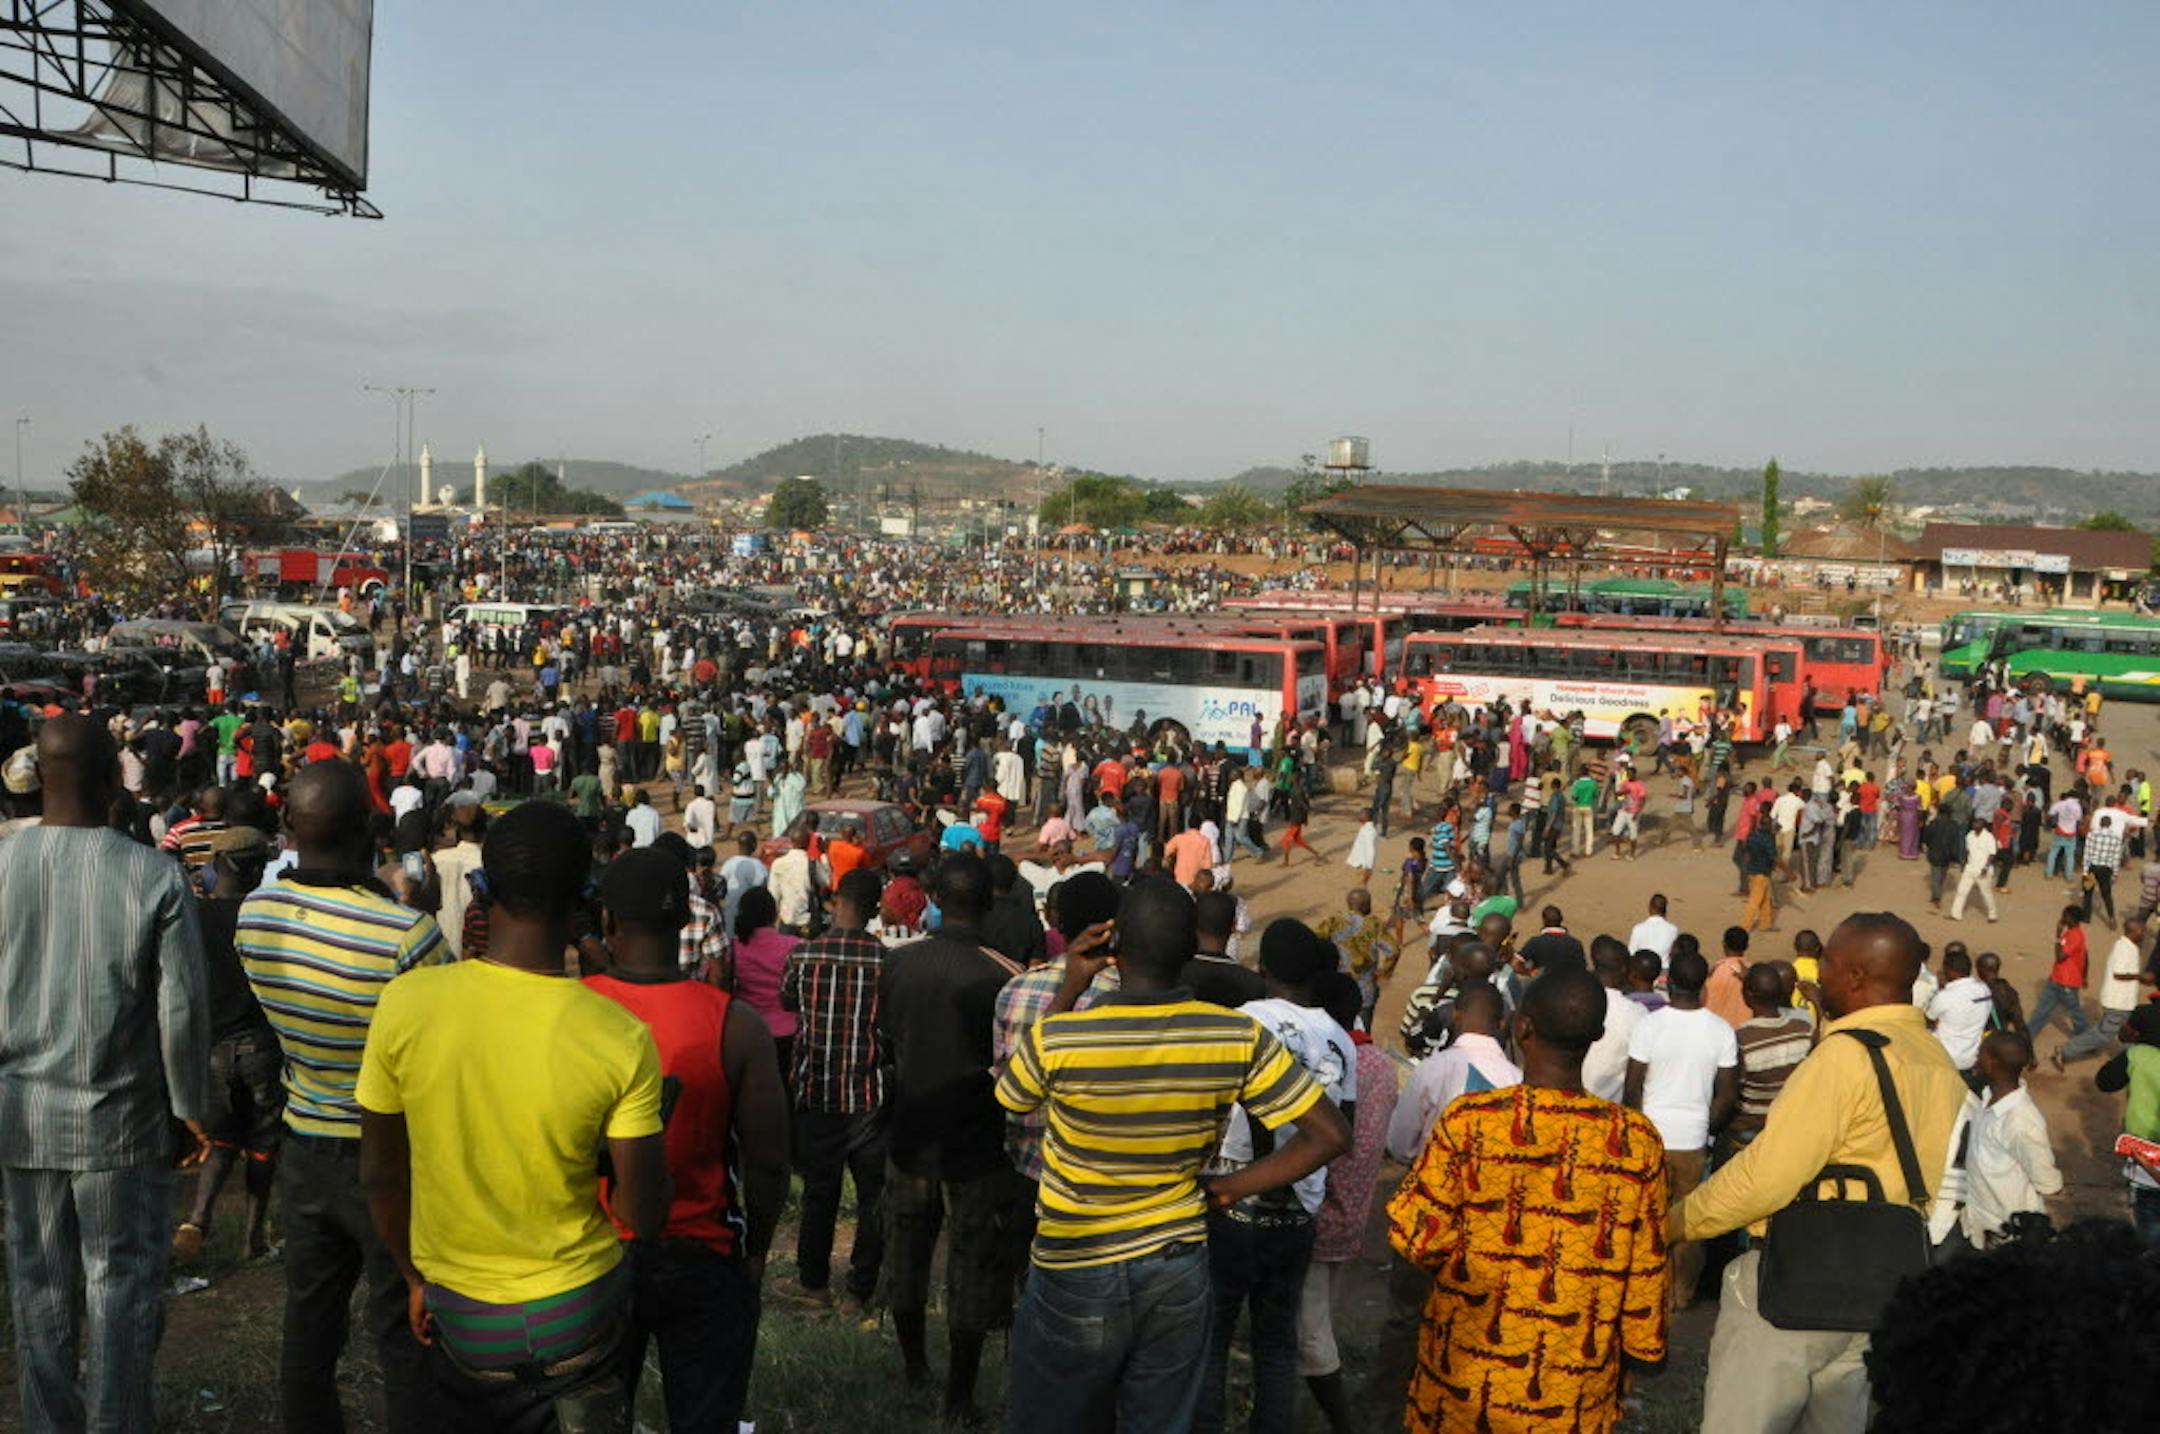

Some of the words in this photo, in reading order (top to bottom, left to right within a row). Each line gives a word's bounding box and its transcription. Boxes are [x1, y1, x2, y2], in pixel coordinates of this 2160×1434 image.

[1550, 692, 1595, 704] Delicious
[1598, 695, 1650, 708] Goodness
[1229, 701, 1258, 716] PAL
